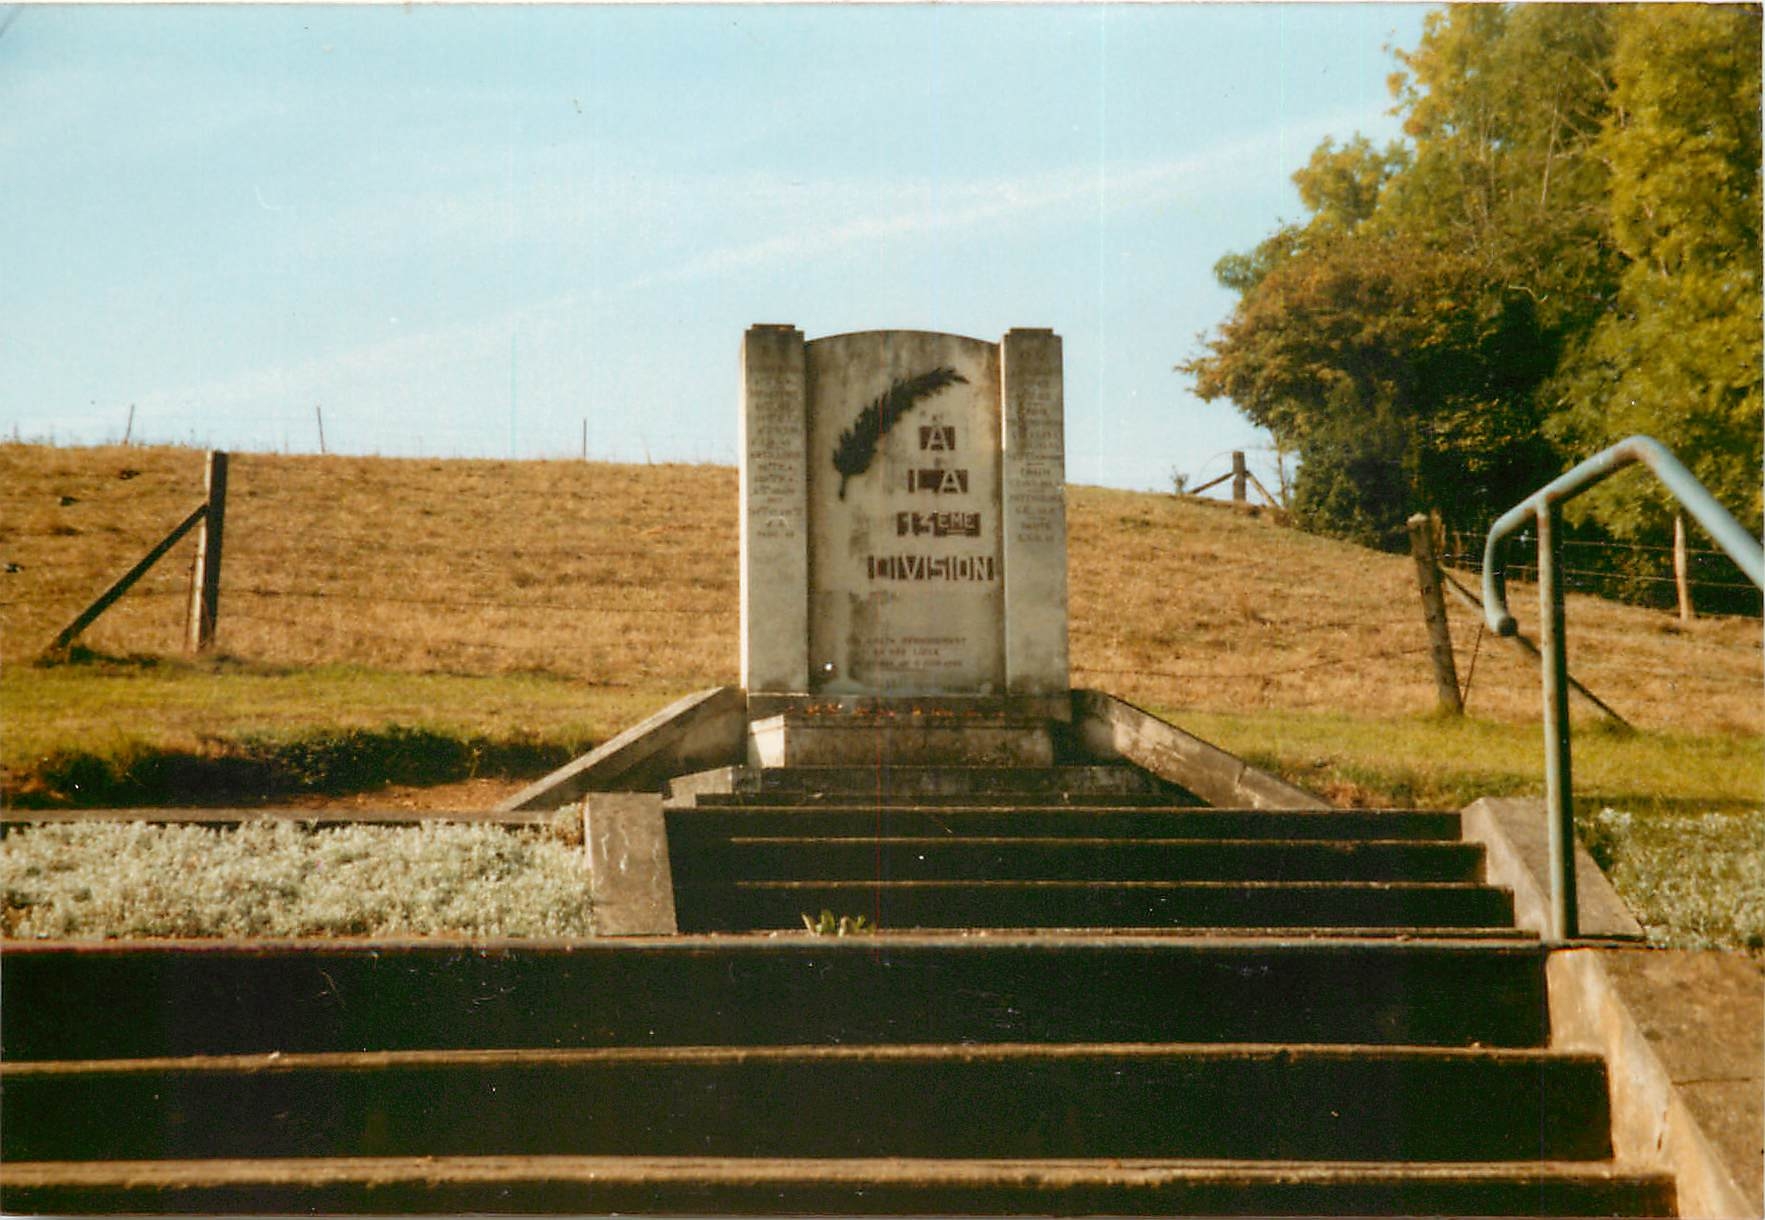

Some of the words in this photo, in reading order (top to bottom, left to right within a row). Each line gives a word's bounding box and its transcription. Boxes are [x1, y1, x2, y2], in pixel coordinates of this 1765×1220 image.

[921, 426, 953, 450] A
[909, 469, 966, 493] LA
[869, 555, 992, 581] DIVISION
